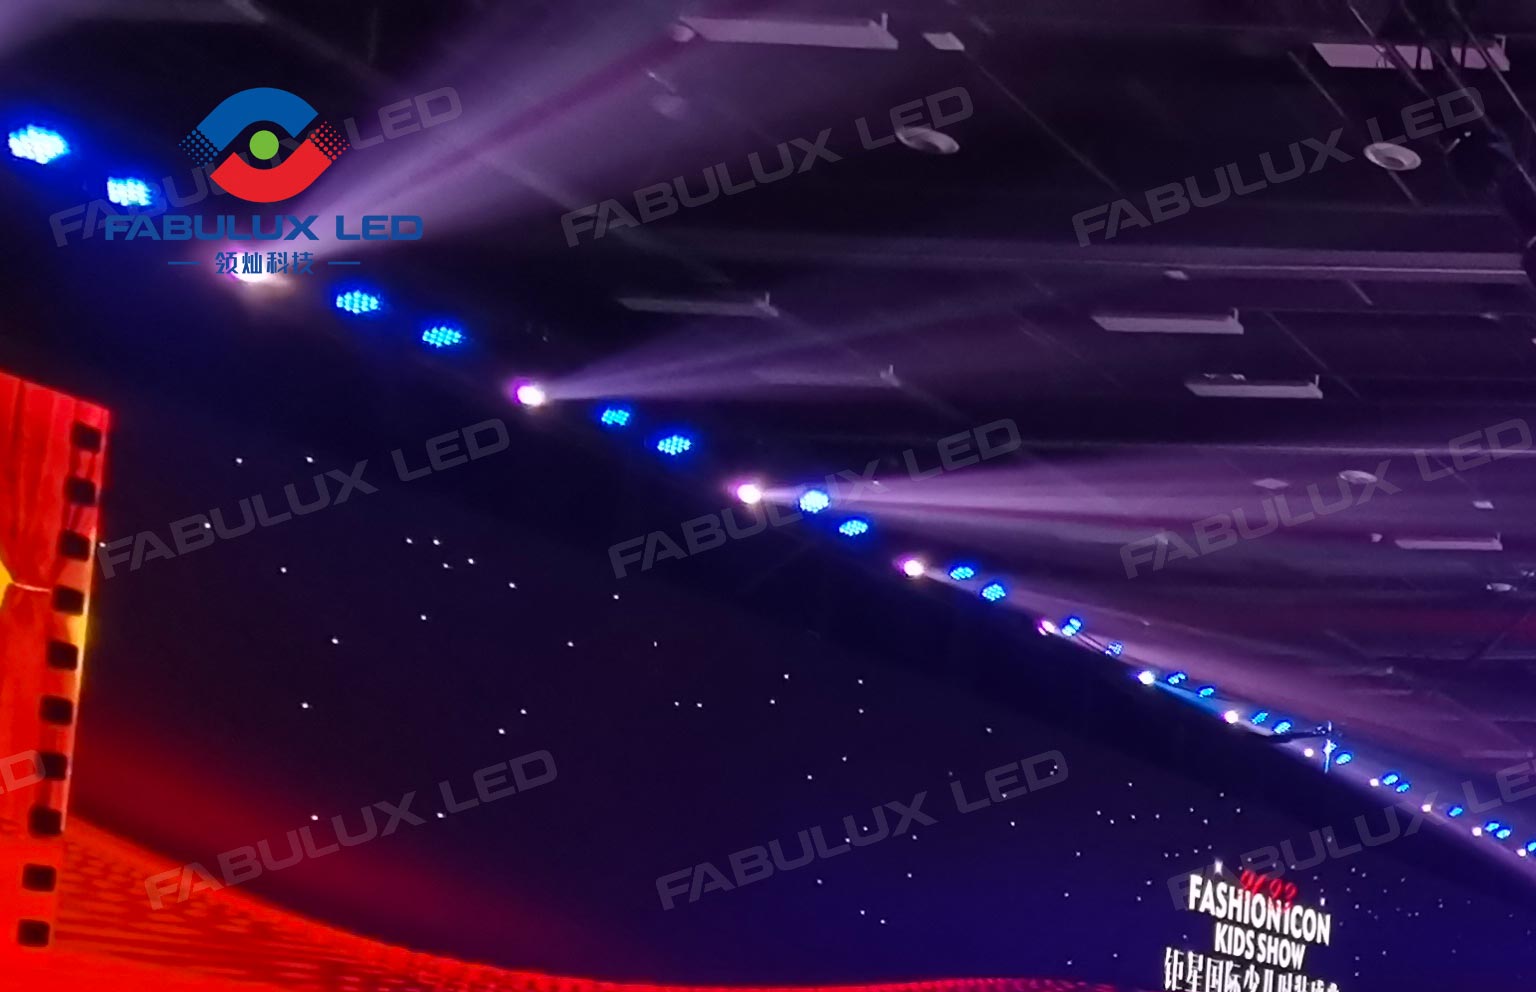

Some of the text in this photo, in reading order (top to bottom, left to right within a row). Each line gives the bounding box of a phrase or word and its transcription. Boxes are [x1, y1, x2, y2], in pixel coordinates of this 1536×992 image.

[1189, 874, 1283, 934] FASHION
[1214, 922, 1306, 970] KIDS SHOW
